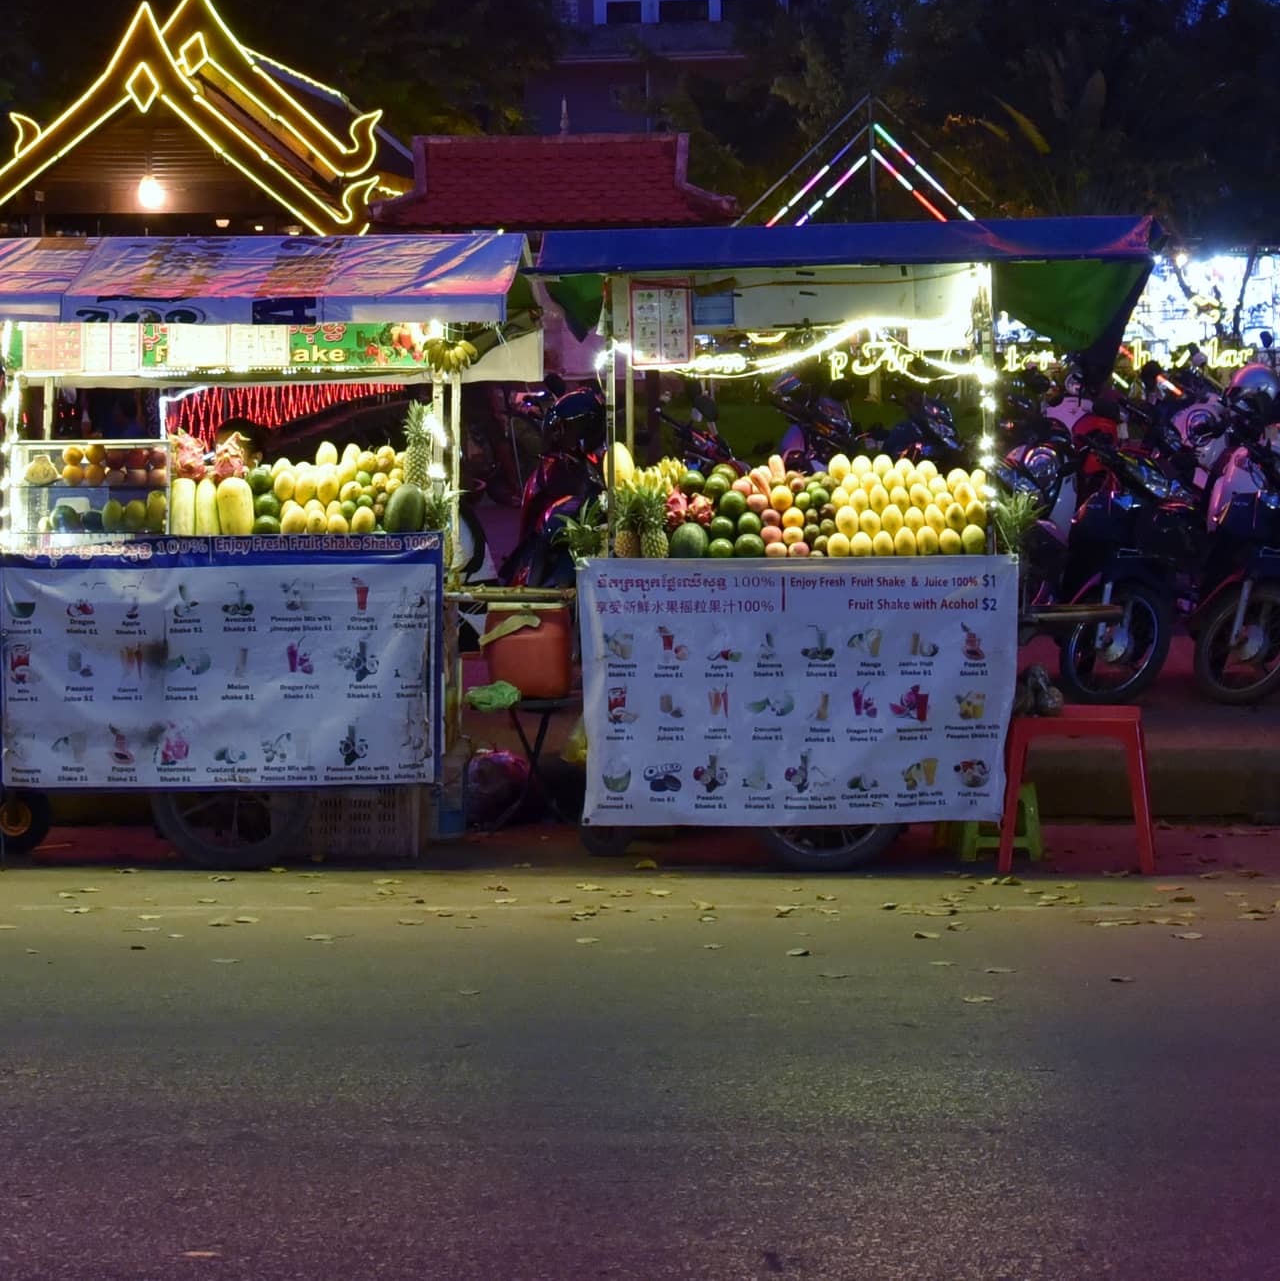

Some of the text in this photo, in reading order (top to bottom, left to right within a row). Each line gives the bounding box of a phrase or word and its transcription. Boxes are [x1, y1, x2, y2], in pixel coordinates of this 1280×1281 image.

[293, 347, 346, 363] ake
[157, 541, 208, 556] 100%
[214, 537, 251, 555] Enjoy
[252, 537, 288, 552] Fresh
[289, 536, 320, 551] Fruit
[322, 536, 360, 551] Shake
[363, 535, 402, 551] Shake
[733, 576, 775, 588] 100%
[790, 574, 996, 590] Enjoy Fresh Fruit Shake & Juice 100% $1
[848, 597, 998, 611] Fruit Shake with Acohol $2
